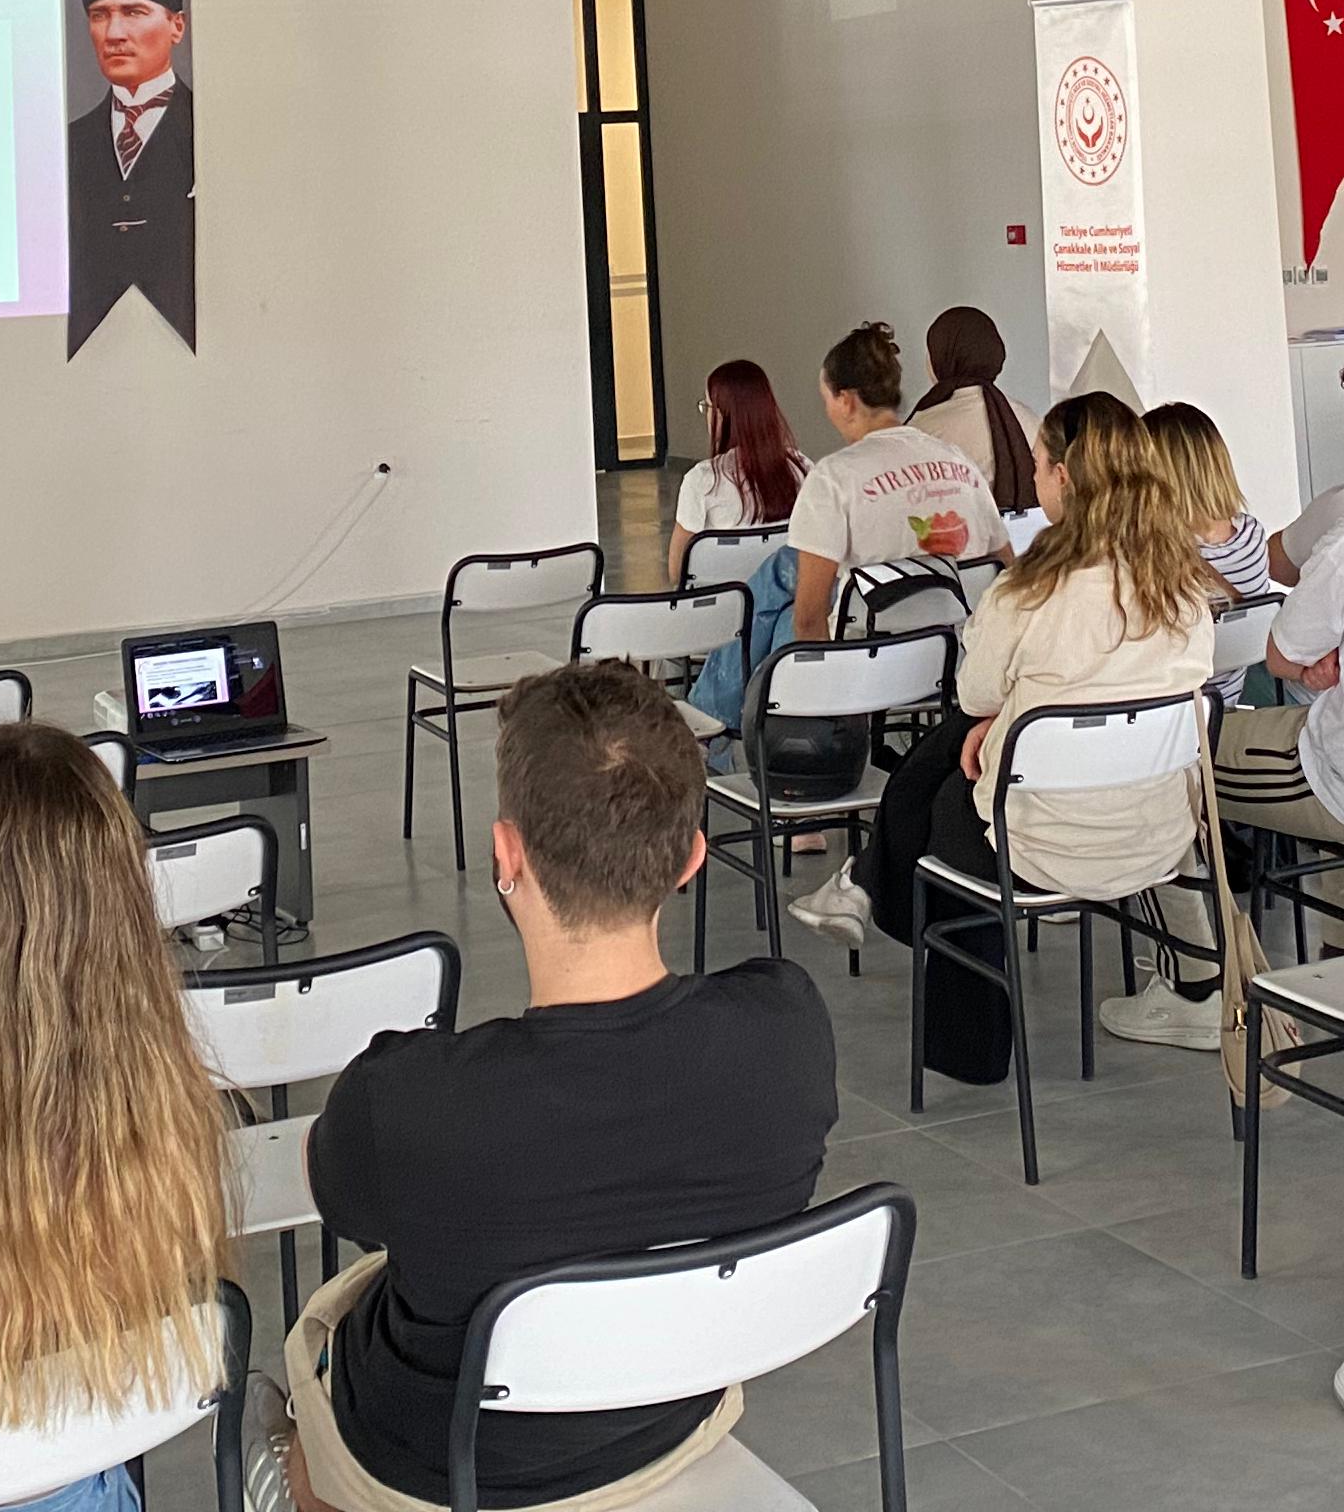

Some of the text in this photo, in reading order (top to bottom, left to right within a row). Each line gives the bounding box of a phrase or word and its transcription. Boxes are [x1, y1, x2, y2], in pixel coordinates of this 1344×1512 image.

[1059, 224, 1133, 239] Türkiye Cumhuriyeti
[1053, 243, 1092, 257] Çanakkale
[1109, 245, 1118, 254] ve
[1119, 242, 1140, 256] Sosyal
[1057, 260, 1093, 272] Hizmetler
